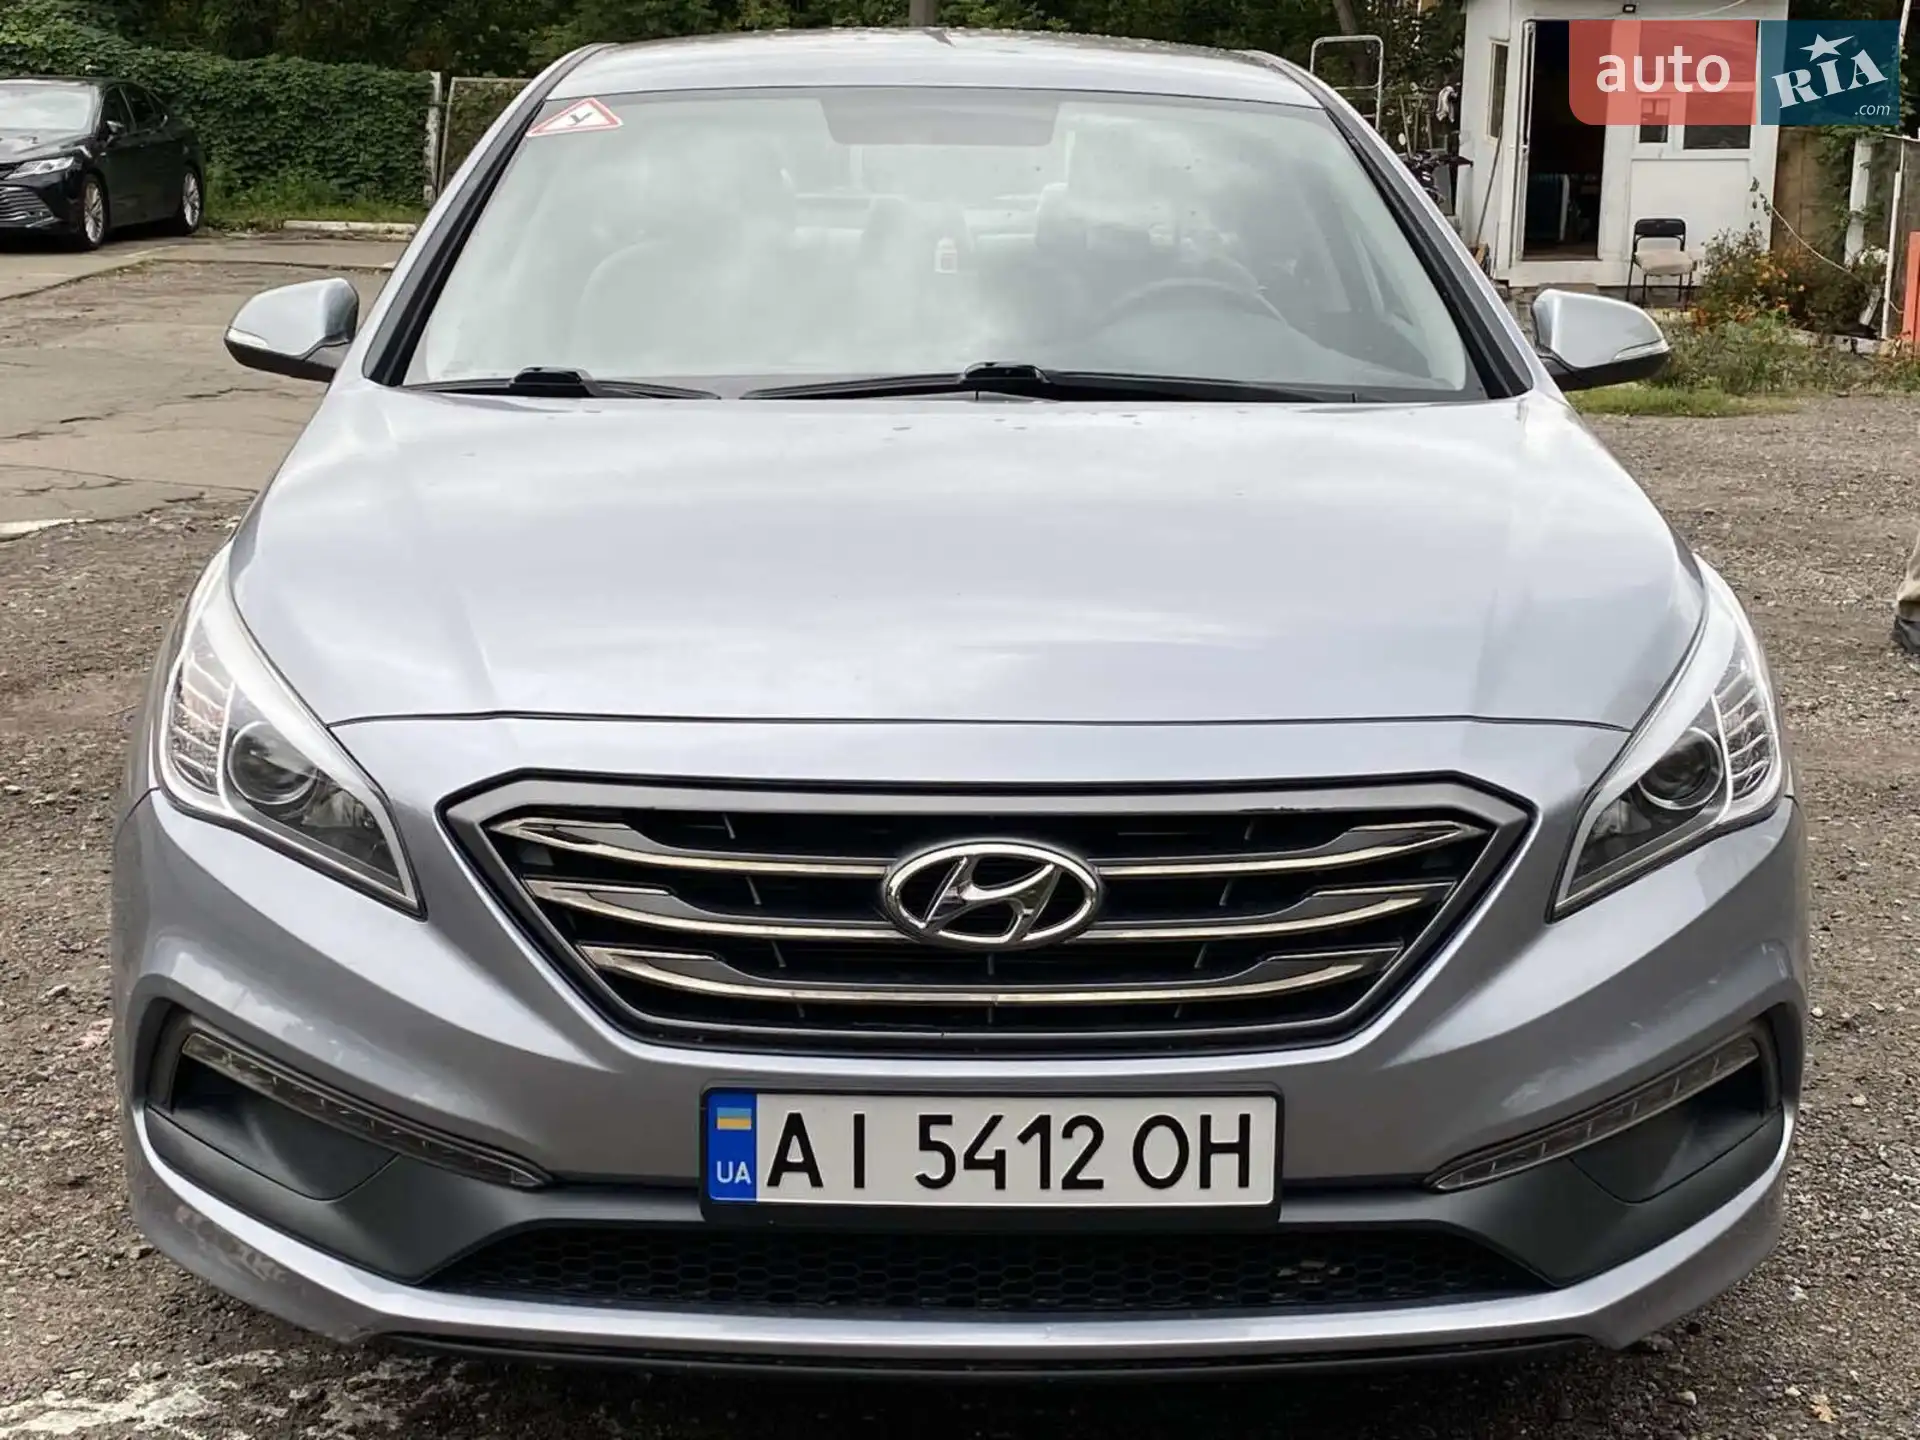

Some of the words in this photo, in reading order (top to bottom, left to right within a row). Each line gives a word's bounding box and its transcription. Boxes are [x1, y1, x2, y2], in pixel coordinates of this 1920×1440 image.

[717, 1161, 751, 1184] UA
[915, 1114, 1105, 1191] 5412
[1132, 1113, 1251, 1190] OH
